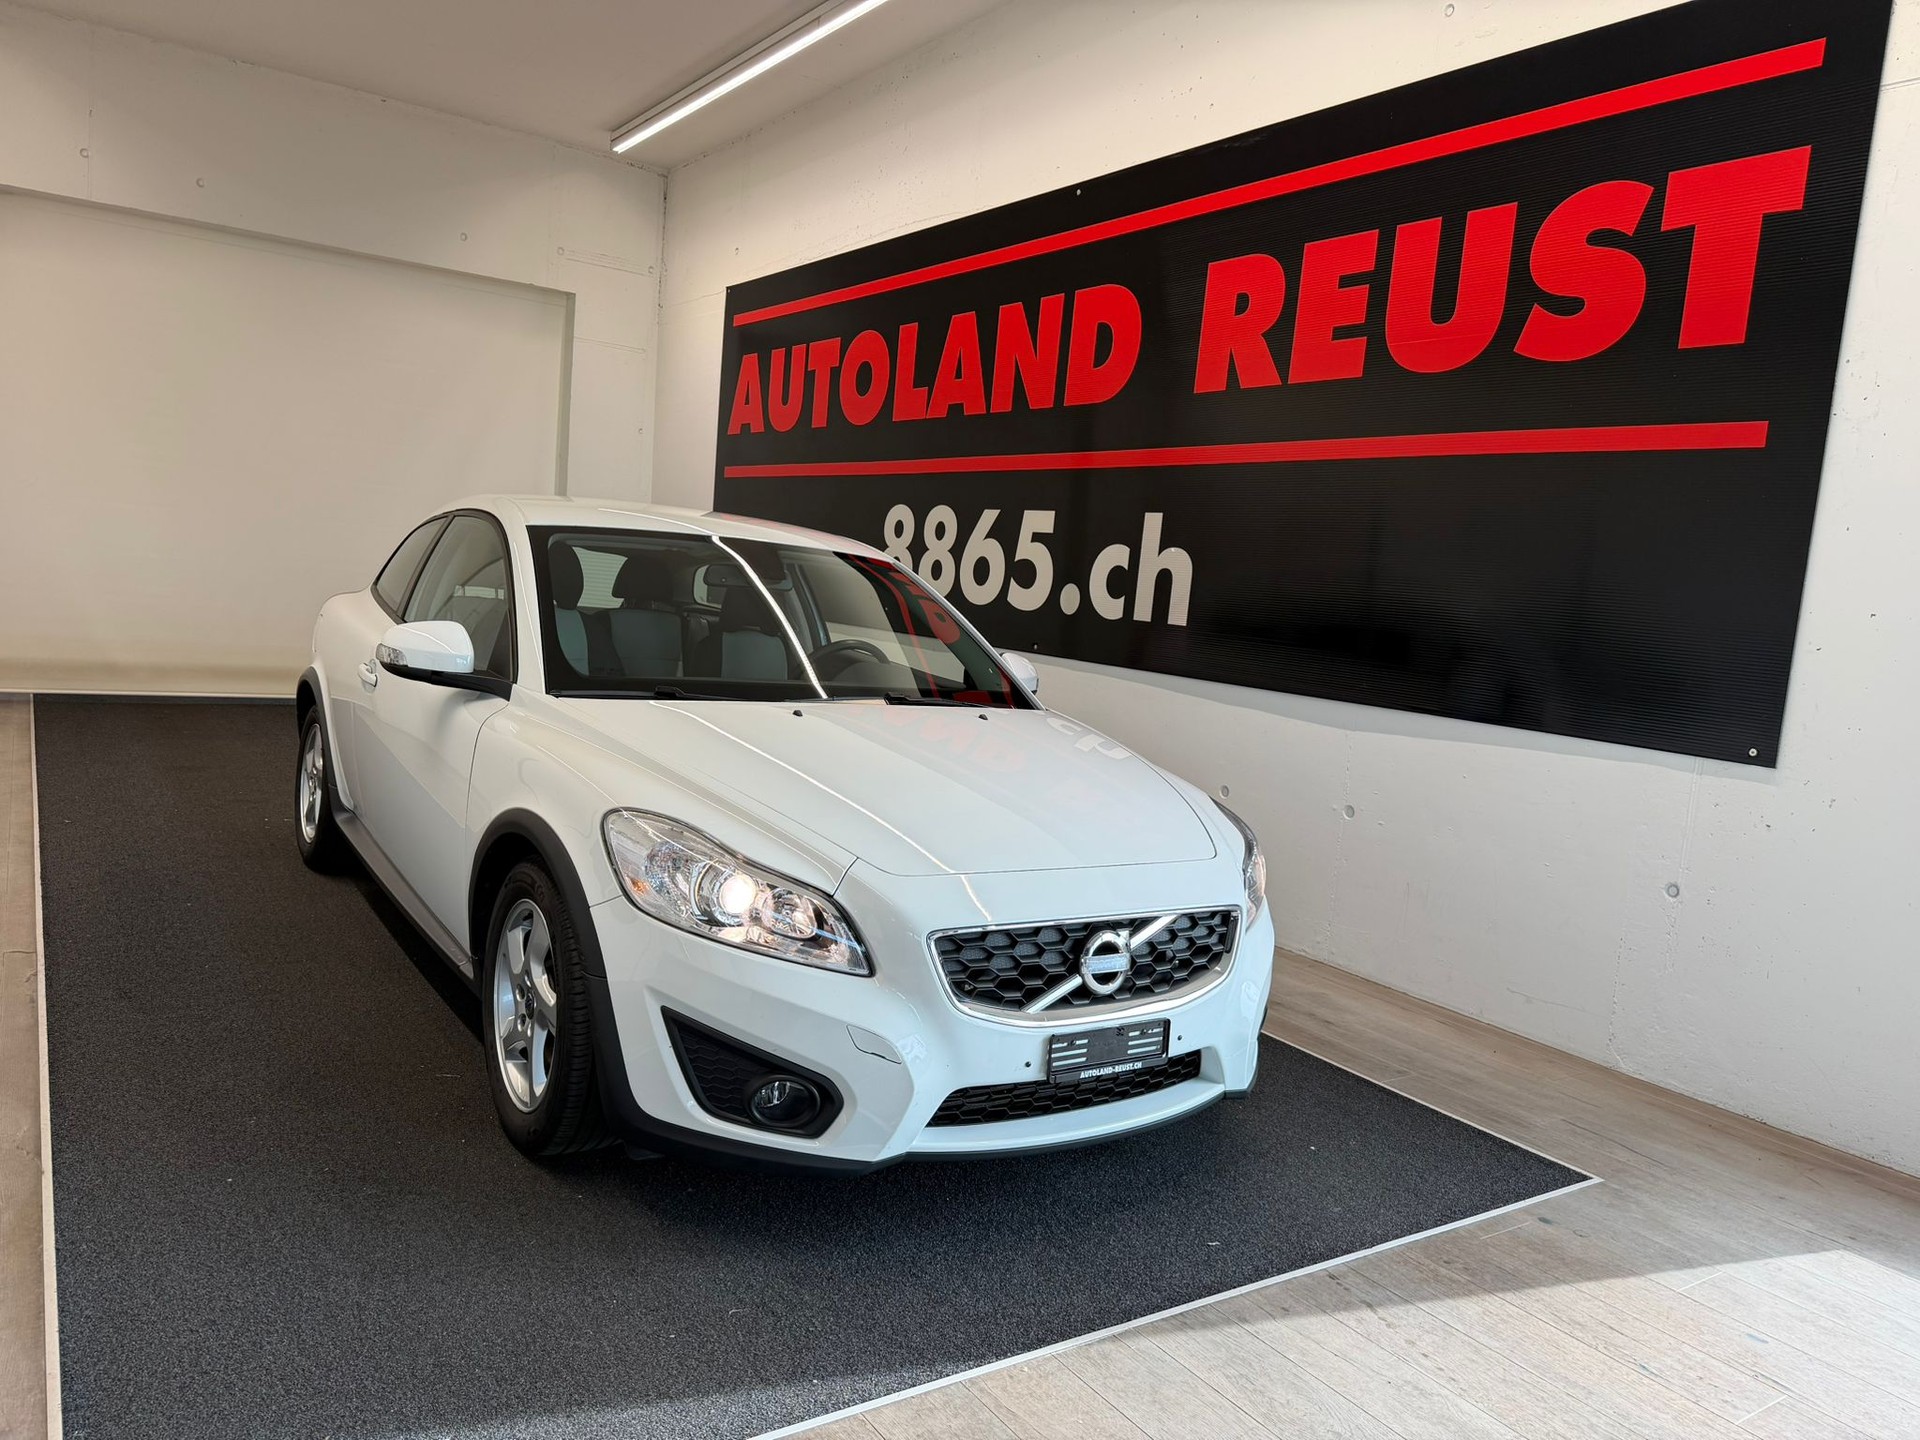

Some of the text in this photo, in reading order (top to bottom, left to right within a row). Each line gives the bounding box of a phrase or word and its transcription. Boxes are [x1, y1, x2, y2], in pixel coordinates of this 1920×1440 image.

[728, 146, 1812, 435] AUTOLAND REUST
[883, 504, 1193, 626] 8865.ch
[1080, 1062, 1143, 1079] AUTOLAND-REUST.CH
